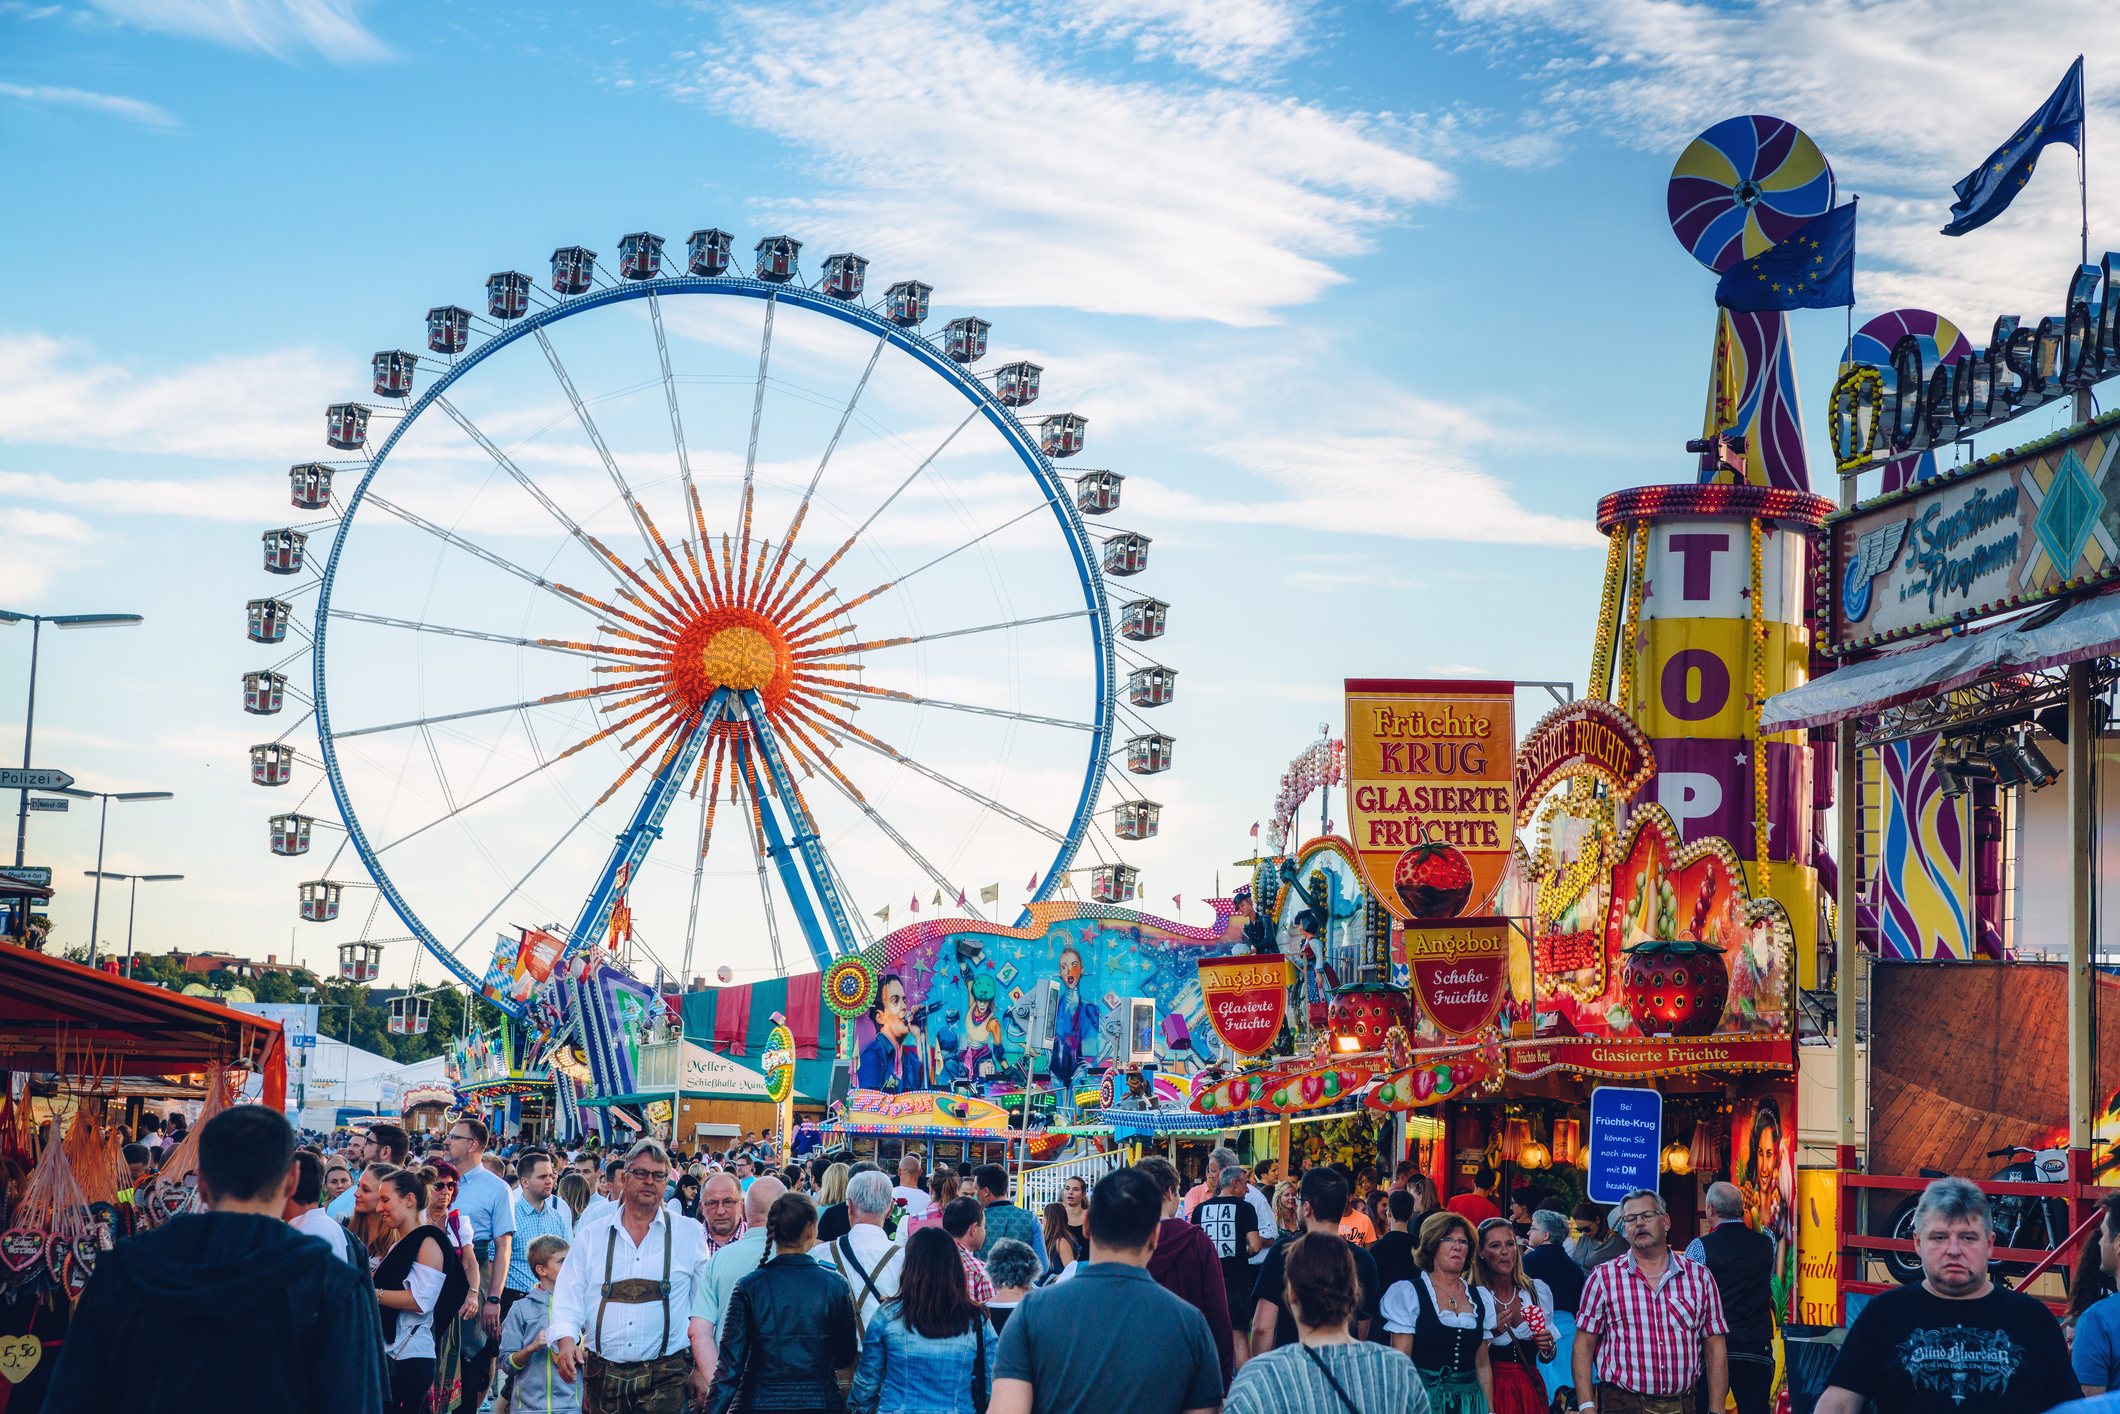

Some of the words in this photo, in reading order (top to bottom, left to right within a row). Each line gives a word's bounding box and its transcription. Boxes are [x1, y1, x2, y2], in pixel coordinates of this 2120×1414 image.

[1889, 251, 2120, 451] Deutschl
[1924, 532, 2018, 614] Programm
[1373, 704, 1491, 739] Früchte
[1378, 741, 1489, 775] KRUG
[1517, 721, 1570, 806] LASIERTE
[1574, 716, 1631, 783] FRÜCHTE
[2, 771, 50, 784] Polizei
[40, 801, 67, 809] Notruf-SOS
[1355, 785, 1511, 815] GLASIERTE
[1367, 815, 1500, 848] FRÜCHTE
[1414, 930, 1501, 958] Angebot
[1208, 966, 1280, 991] Angebot
[1432, 968, 1490, 985] Schoko-
[1433, 988, 1490, 1006] Früchte
[1218, 1000, 1274, 1018] Glasierte
[1224, 1016, 1272, 1031] Früchte
[295, 1037, 303, 1045] U
[1516, 1051, 1537, 1064] Früchte
[1537, 1050, 1551, 1063] Krug
[1592, 1047, 1662, 1062] Glasierte
[1667, 1047, 1729, 1062] Früchte
[686, 1077, 737, 1089] Schießhalle
[739, 1080, 767, 1090] Münc
[1619, 1103, 1632, 1111] Bei
[1595, 1116, 1655, 1131] Früchte-Krug
[1604, 1133, 1632, 1143] können
[1634, 1135, 1646, 1144] Sie
[1621, 1150, 1648, 1159] immer
[1606, 1166, 1620, 1174] mit
[1621, 1165, 1637, 1175] DM
[1910, 1346, 1947, 1362] Blind
[1947, 1341, 2010, 1364] Guardian
